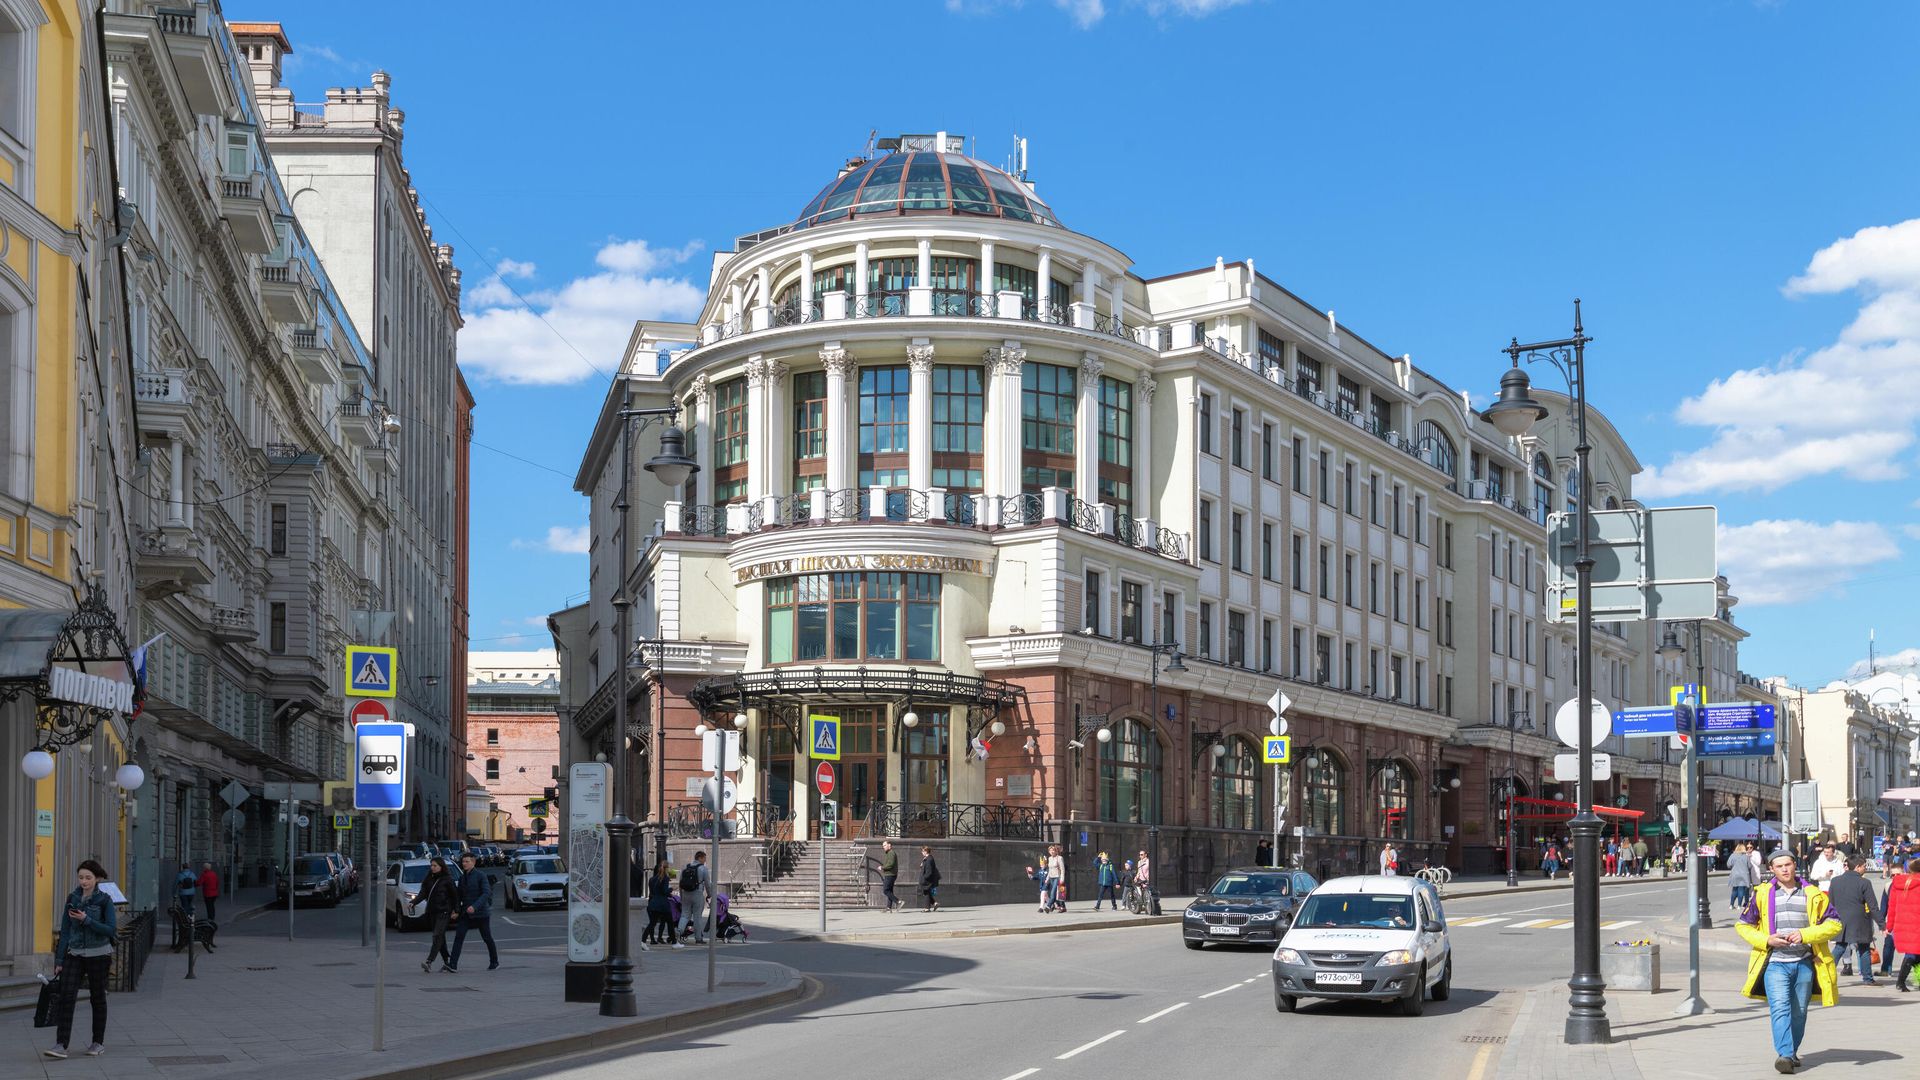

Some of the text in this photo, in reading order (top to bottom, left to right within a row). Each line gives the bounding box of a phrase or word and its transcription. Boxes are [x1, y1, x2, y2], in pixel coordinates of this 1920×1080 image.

[738, 554, 983, 581] ВЫСШАЯ ШКОЛА ЭКОНОМИКИ
[52, 666, 135, 714] ПОПЛАВОК
